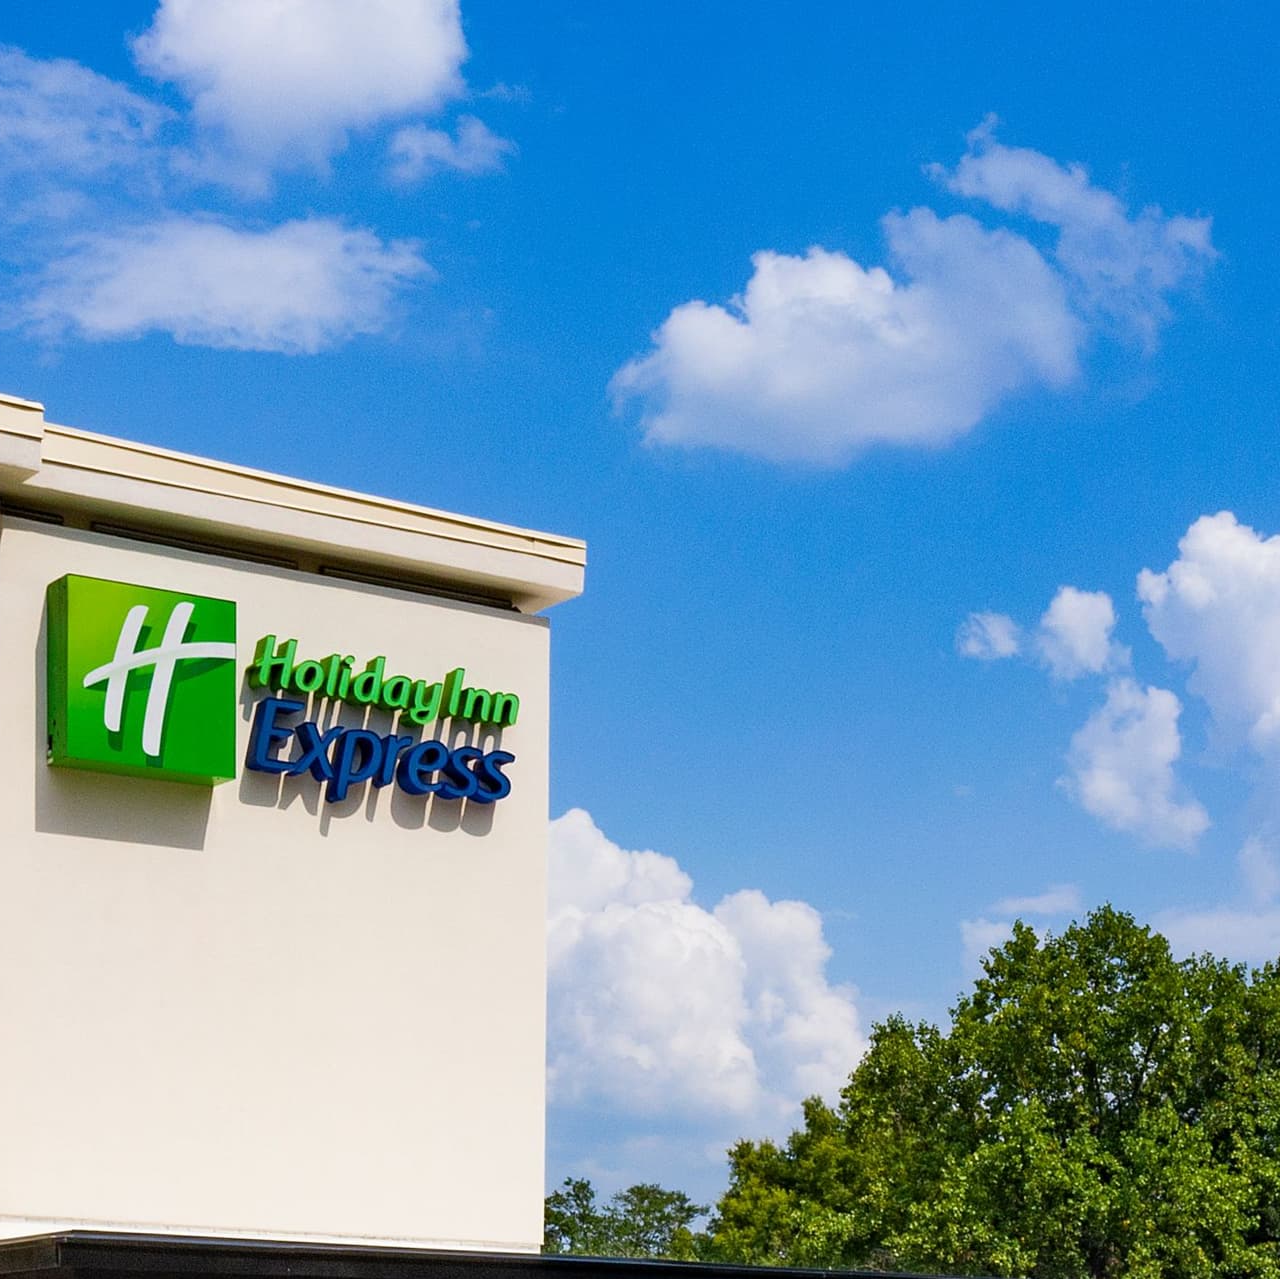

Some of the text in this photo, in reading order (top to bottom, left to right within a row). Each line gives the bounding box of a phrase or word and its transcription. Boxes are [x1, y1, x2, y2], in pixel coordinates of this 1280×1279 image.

[248, 634, 520, 729] Holiday Inn
[245, 696, 516, 804] Express
